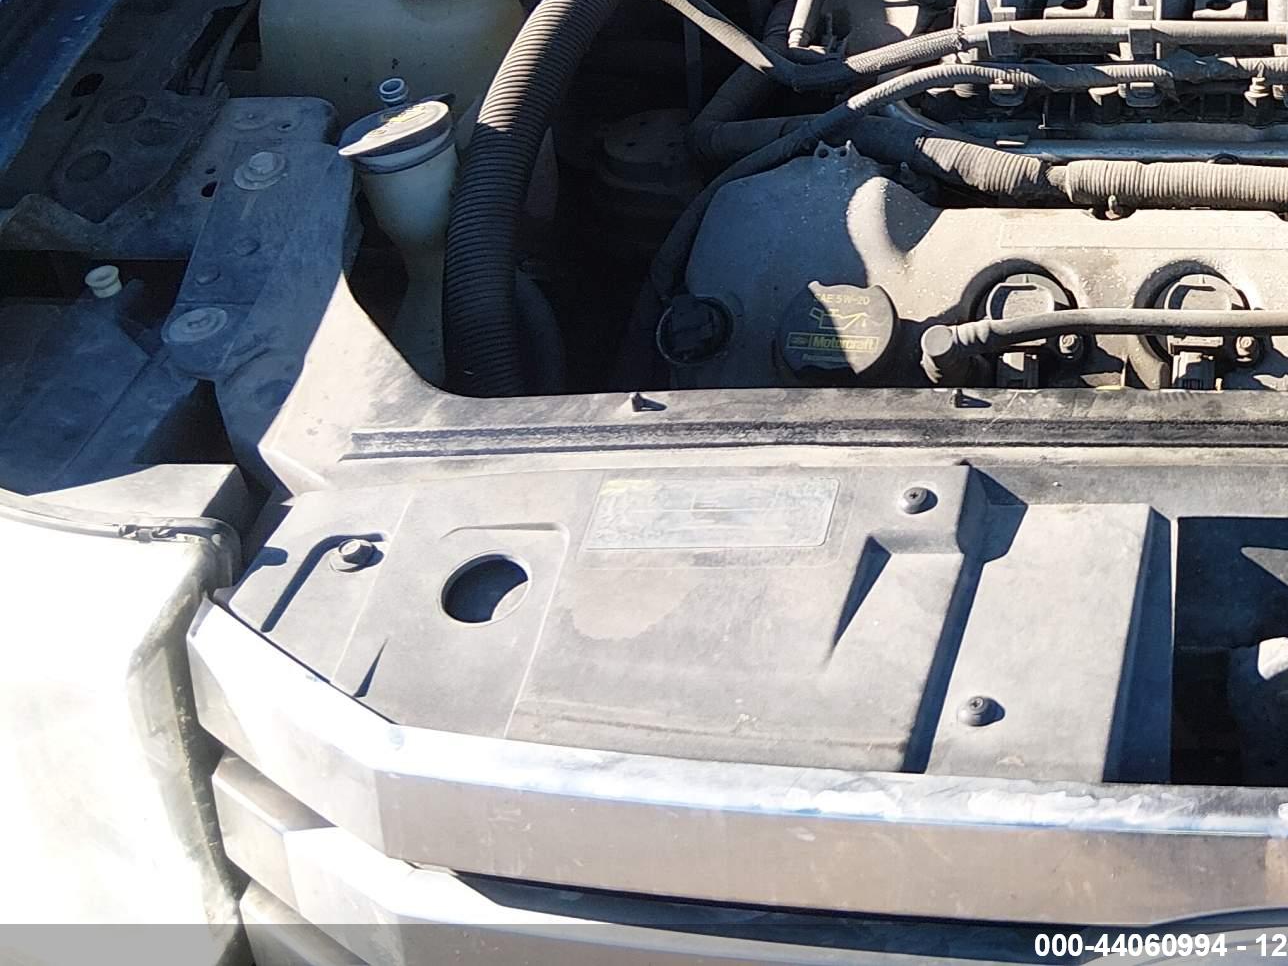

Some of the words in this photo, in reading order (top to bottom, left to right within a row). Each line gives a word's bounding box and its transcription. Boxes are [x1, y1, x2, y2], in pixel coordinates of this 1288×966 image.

[814, 293, 833, 303] SAE
[836, 294, 871, 306] 5W-20
[813, 336, 874, 350] Motorcraft
